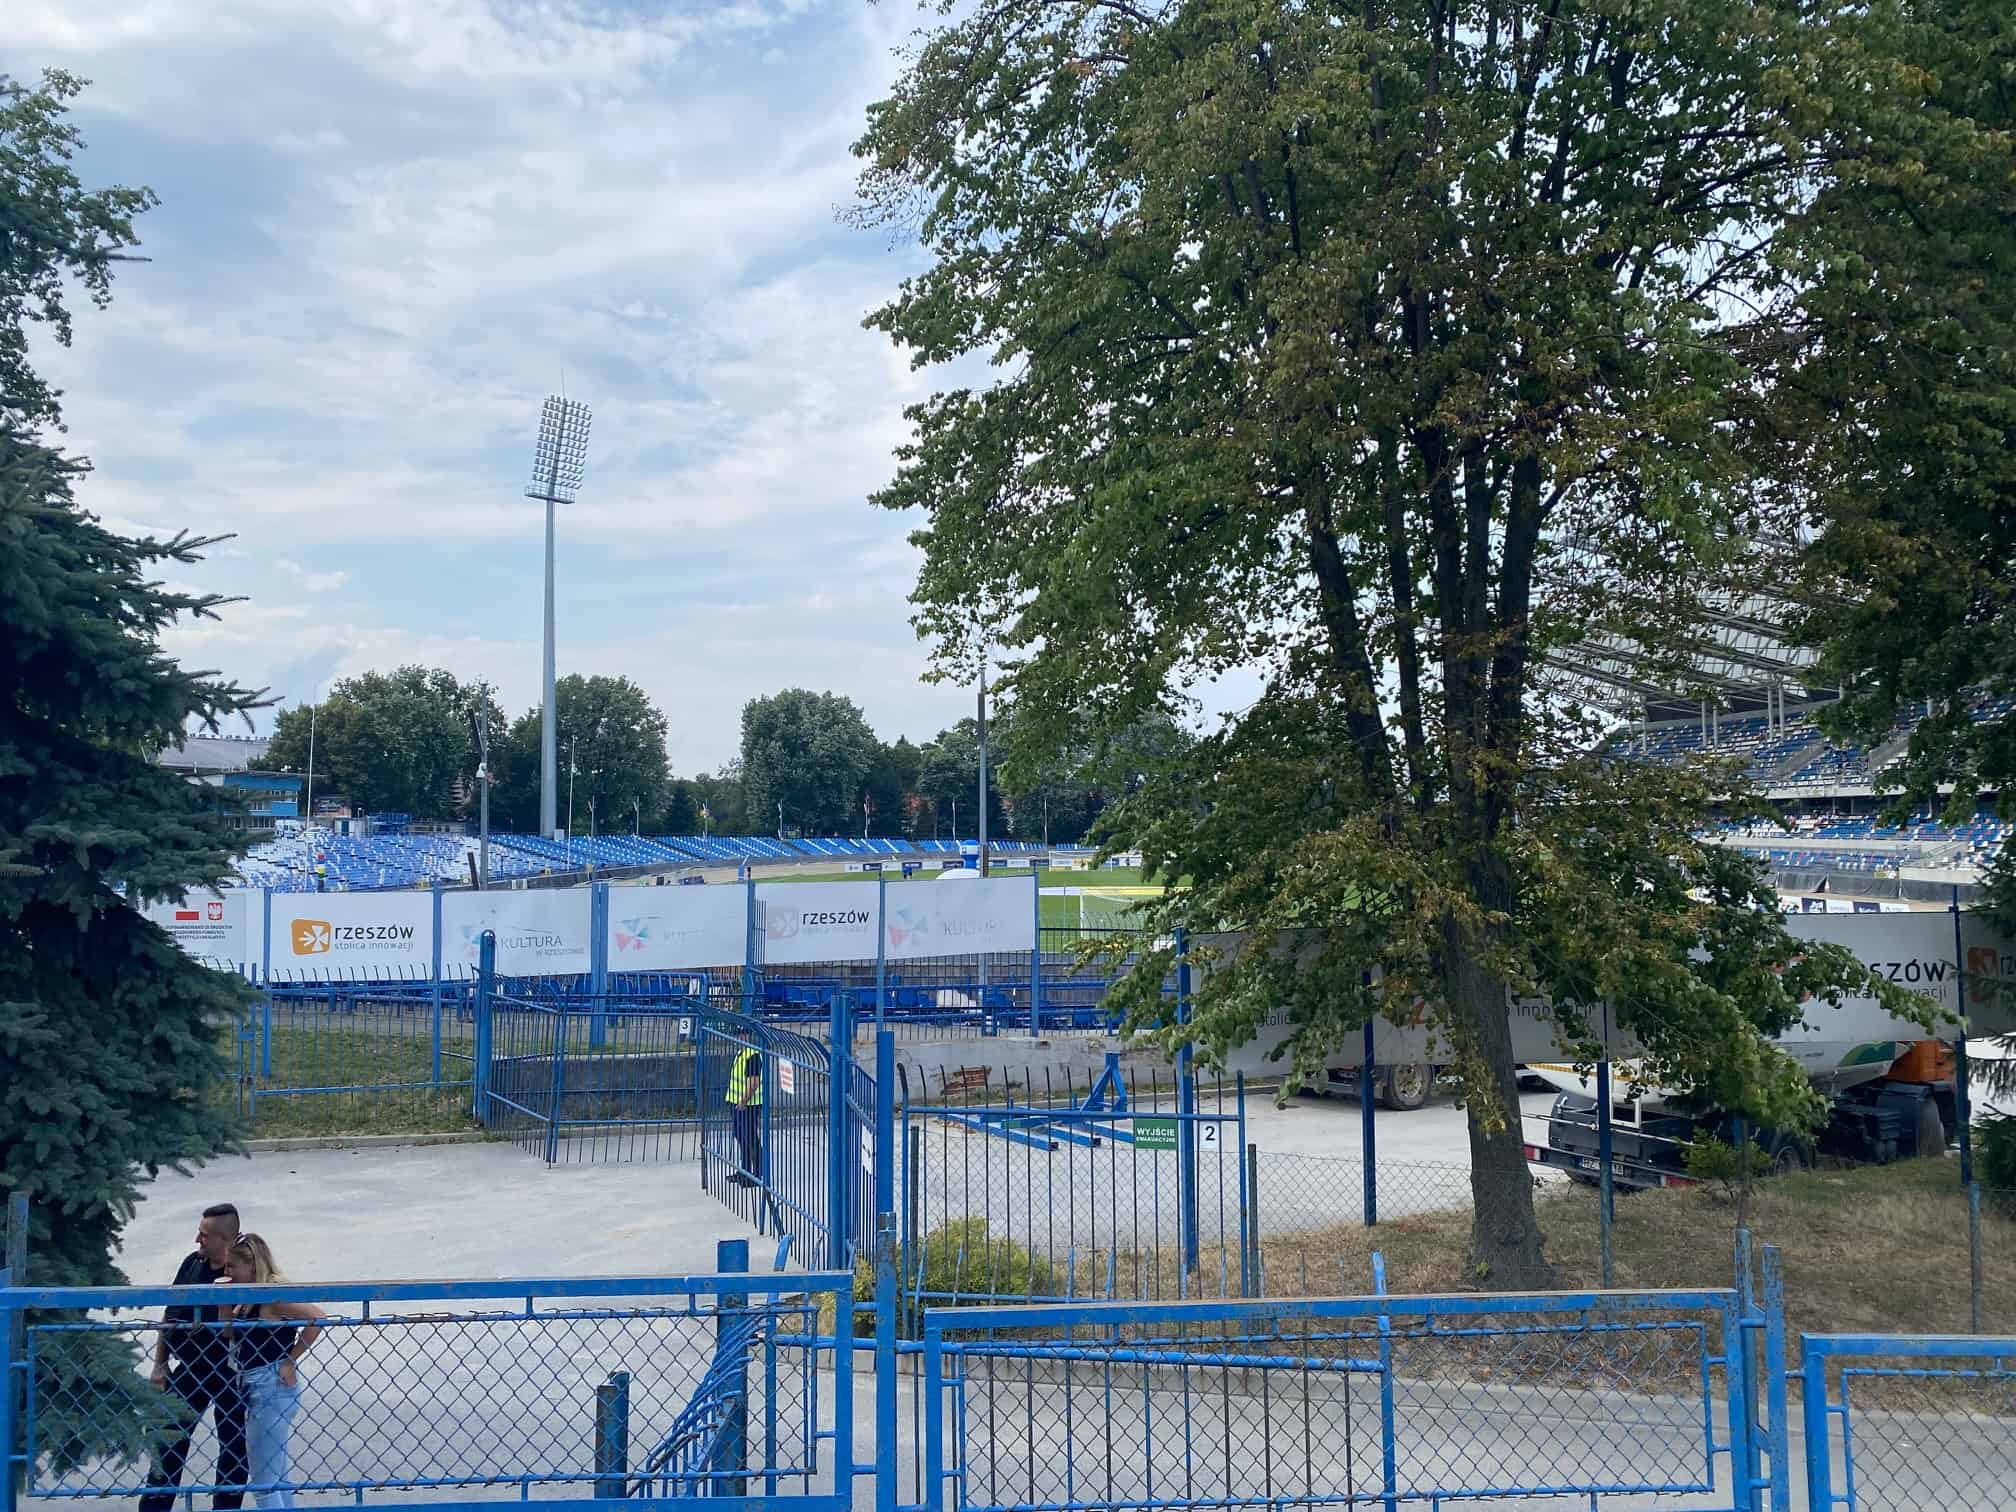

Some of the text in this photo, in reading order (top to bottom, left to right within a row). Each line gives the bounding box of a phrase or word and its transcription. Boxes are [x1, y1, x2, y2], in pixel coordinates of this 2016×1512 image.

[803, 909, 870, 925] rzeszów
[335, 924, 414, 939] rzeszów
[335, 941, 366, 950] stolica
[501, 936, 563, 949] KULTURA
[1860, 959, 1946, 983] szów
[682, 1020, 689, 1029] 3
[1136, 1126, 1175, 1136] WYJŚCIE
[1205, 1126, 1216, 1141] 2
